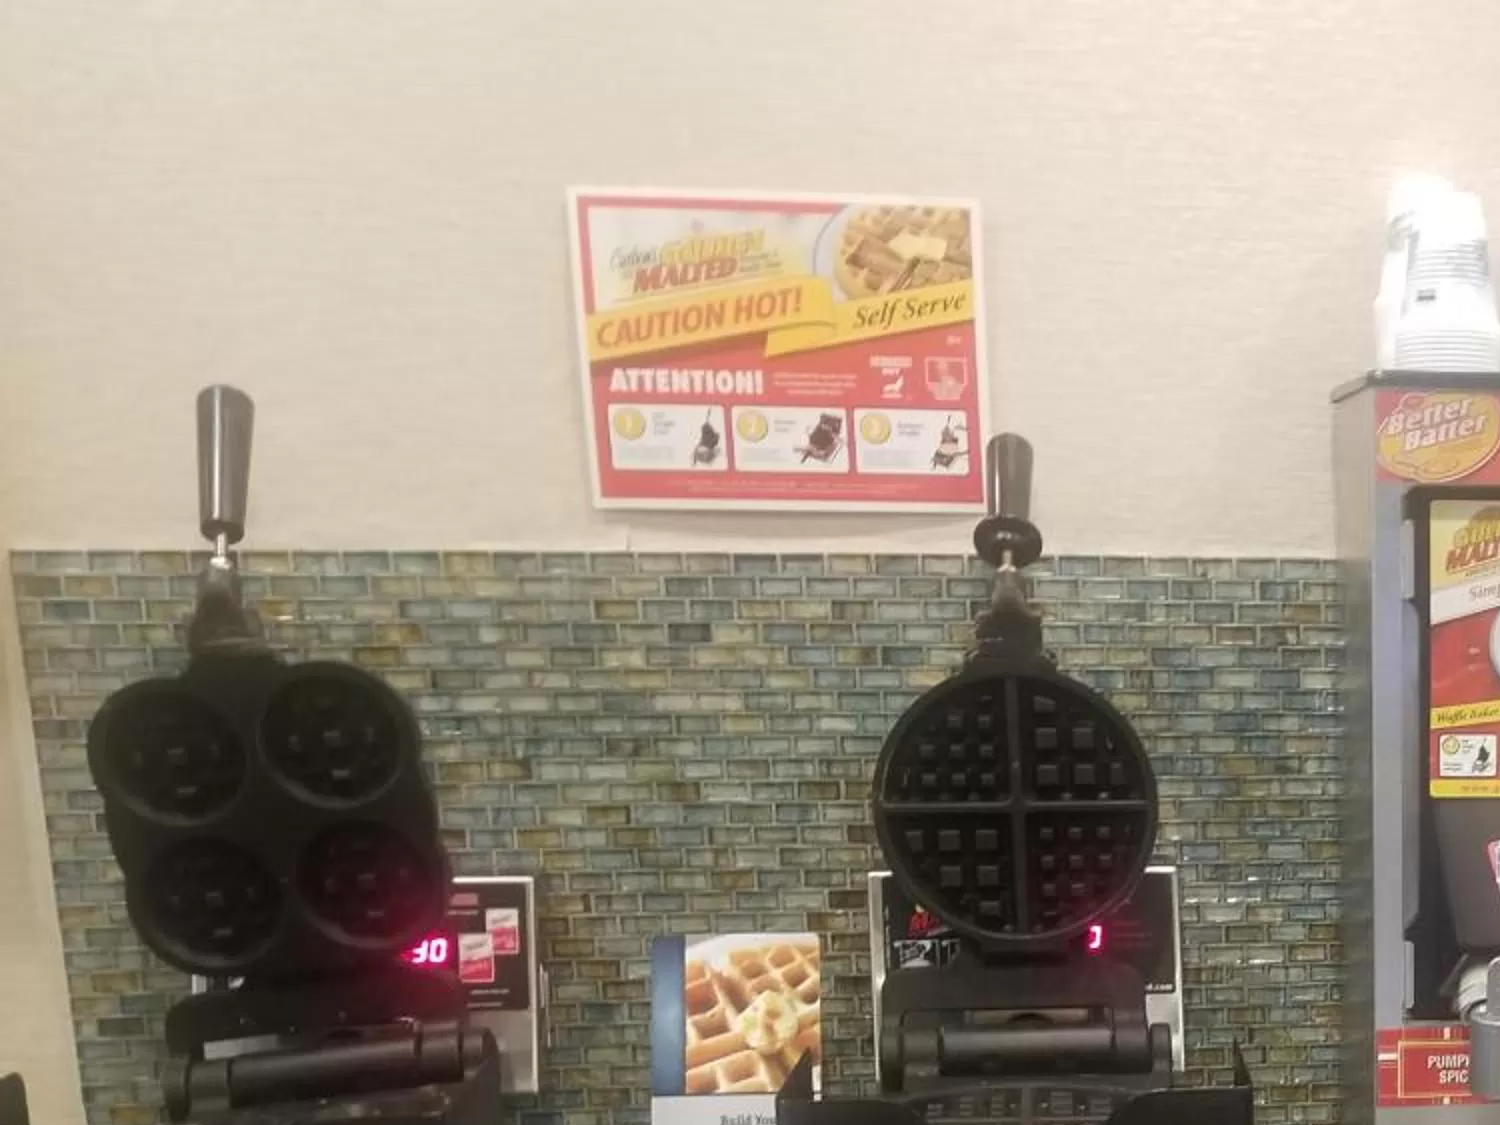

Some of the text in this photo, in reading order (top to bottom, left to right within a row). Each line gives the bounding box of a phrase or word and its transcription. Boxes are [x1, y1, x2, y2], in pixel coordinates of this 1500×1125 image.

[633, 256, 739, 293] MALTED
[597, 286, 804, 347] CAUTION HOT!
[852, 293, 967, 330] Self Serve
[609, 368, 765, 395] ATTENTION!
[1387, 398, 1473, 434] Better
[1405, 415, 1487, 451] Batter
